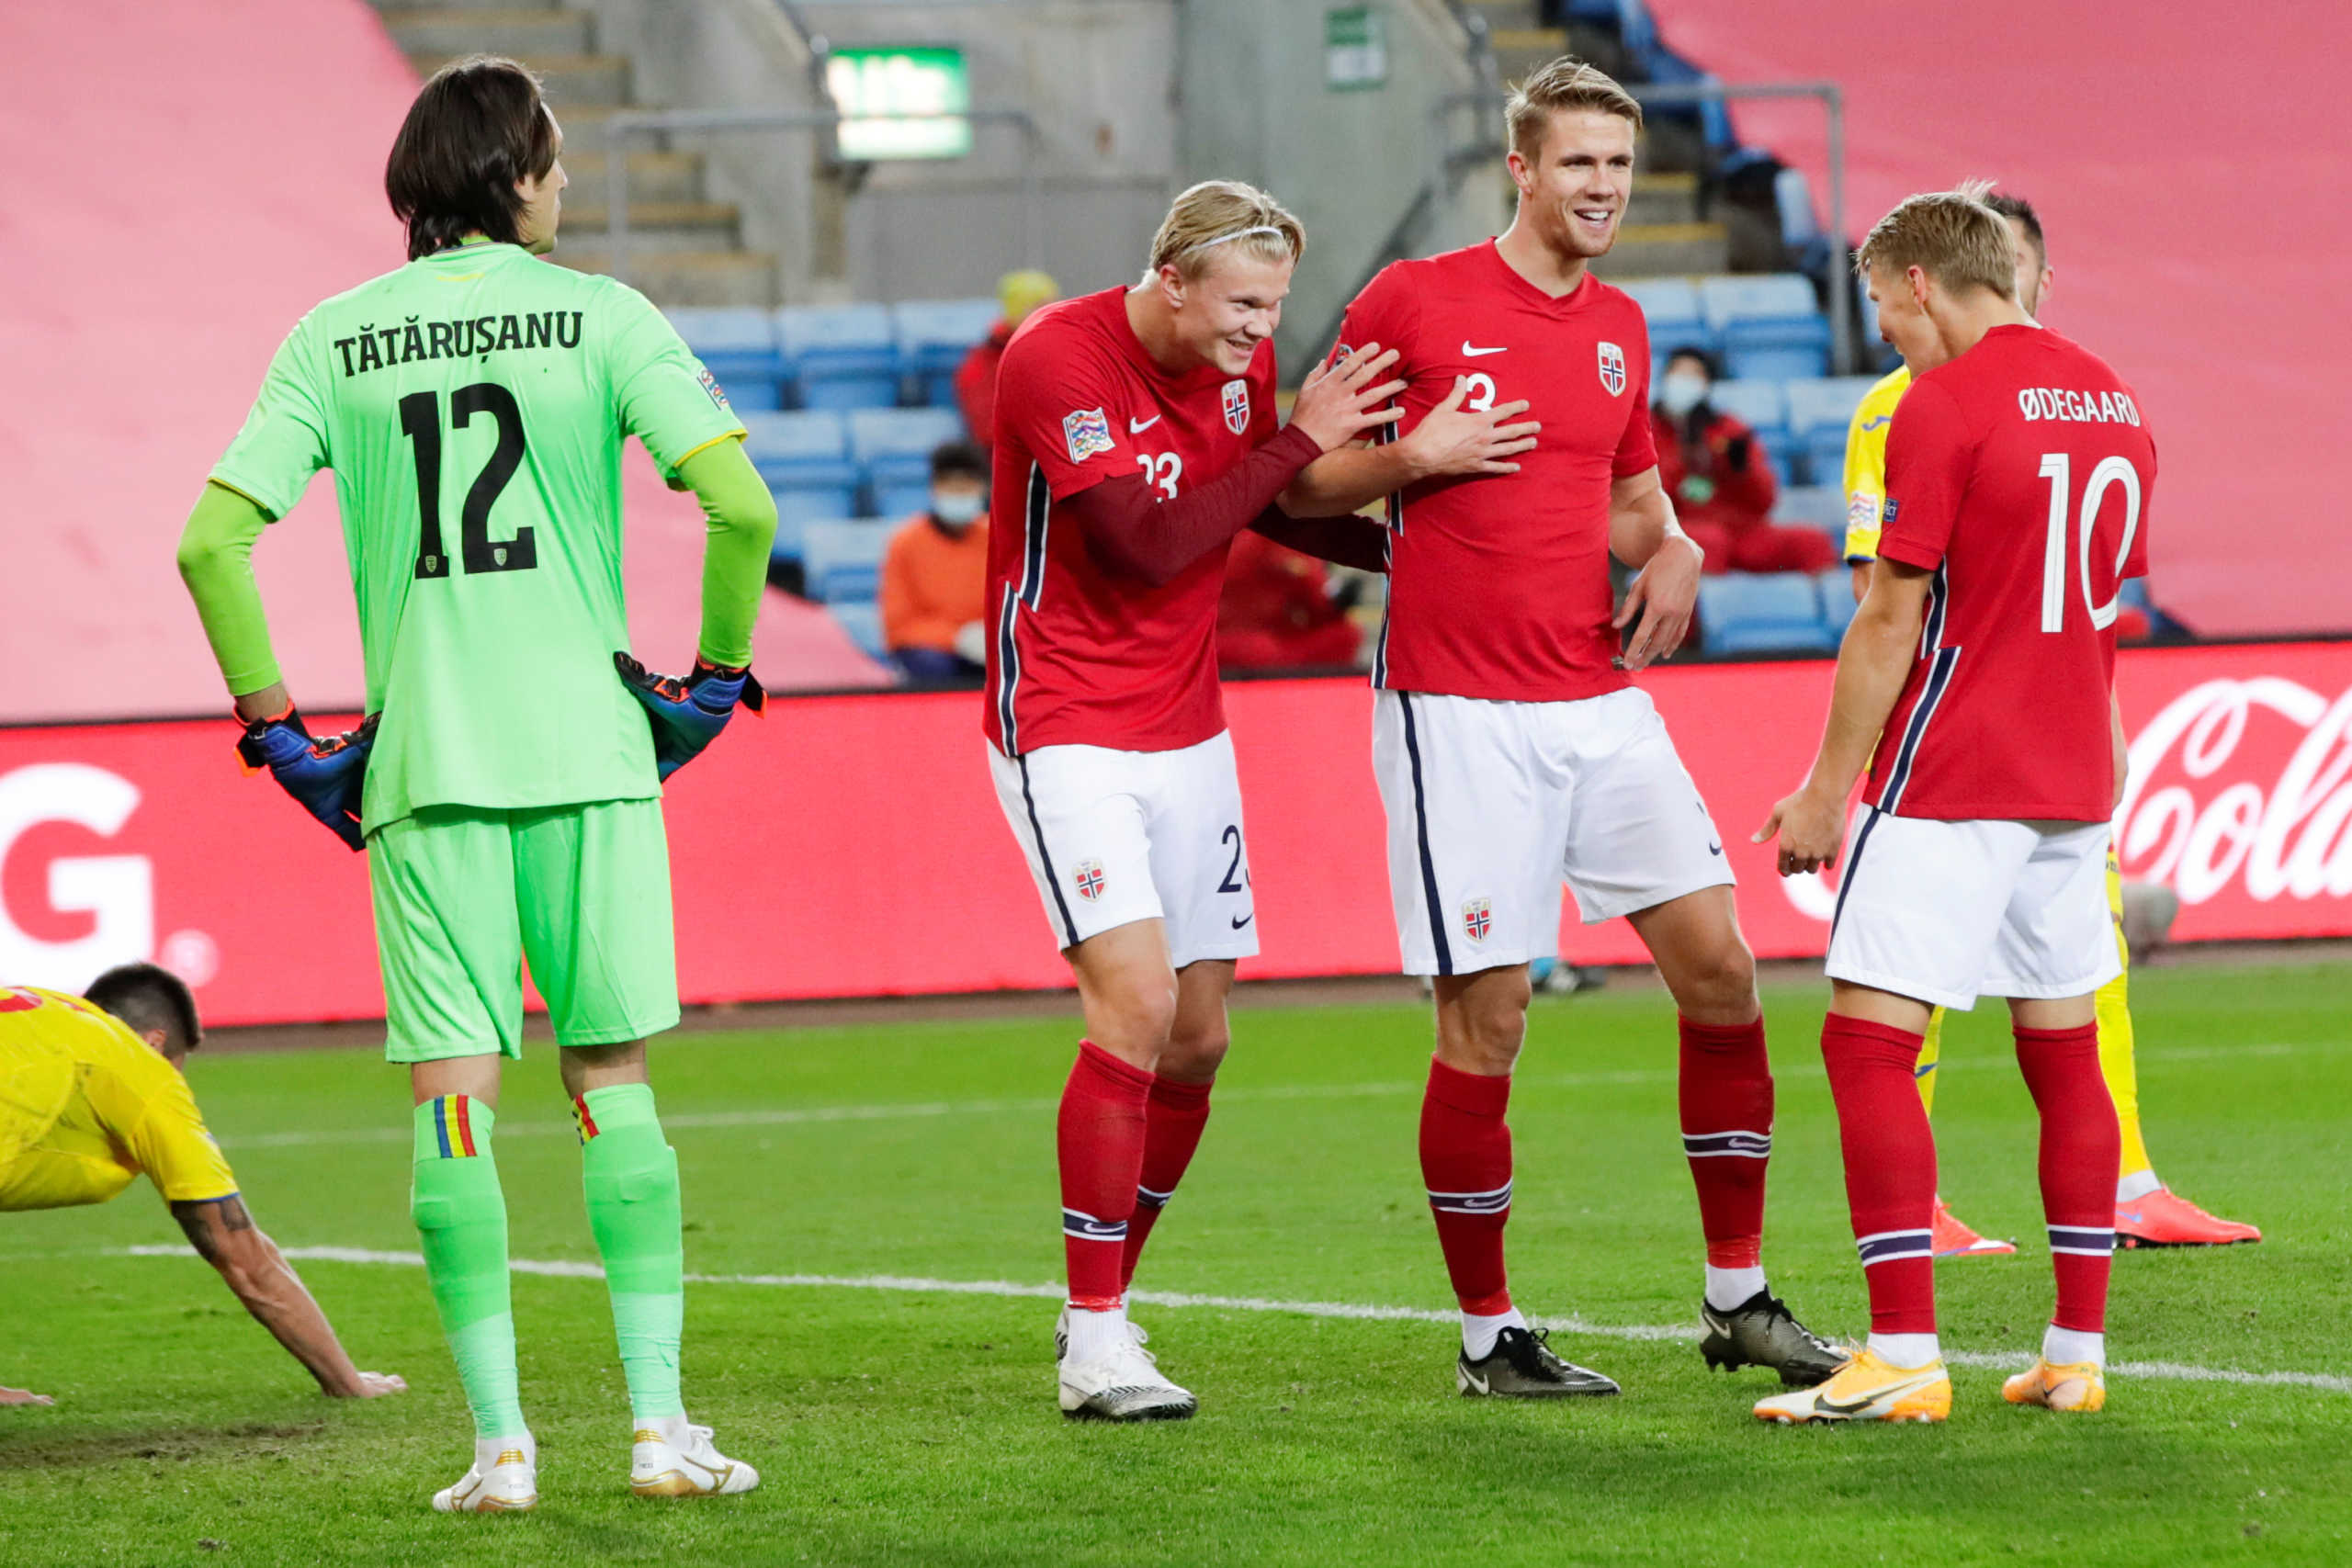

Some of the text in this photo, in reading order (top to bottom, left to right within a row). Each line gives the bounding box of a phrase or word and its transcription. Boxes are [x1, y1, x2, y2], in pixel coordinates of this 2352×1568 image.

[334, 310, 583, 378] TĂTĂRUȘANU
[2018, 387, 2142, 427] ØDEGAARD
[399, 382, 538, 581] 12
[2037, 452, 2142, 634] 10
[1216, 824, 1251, 894] 2
